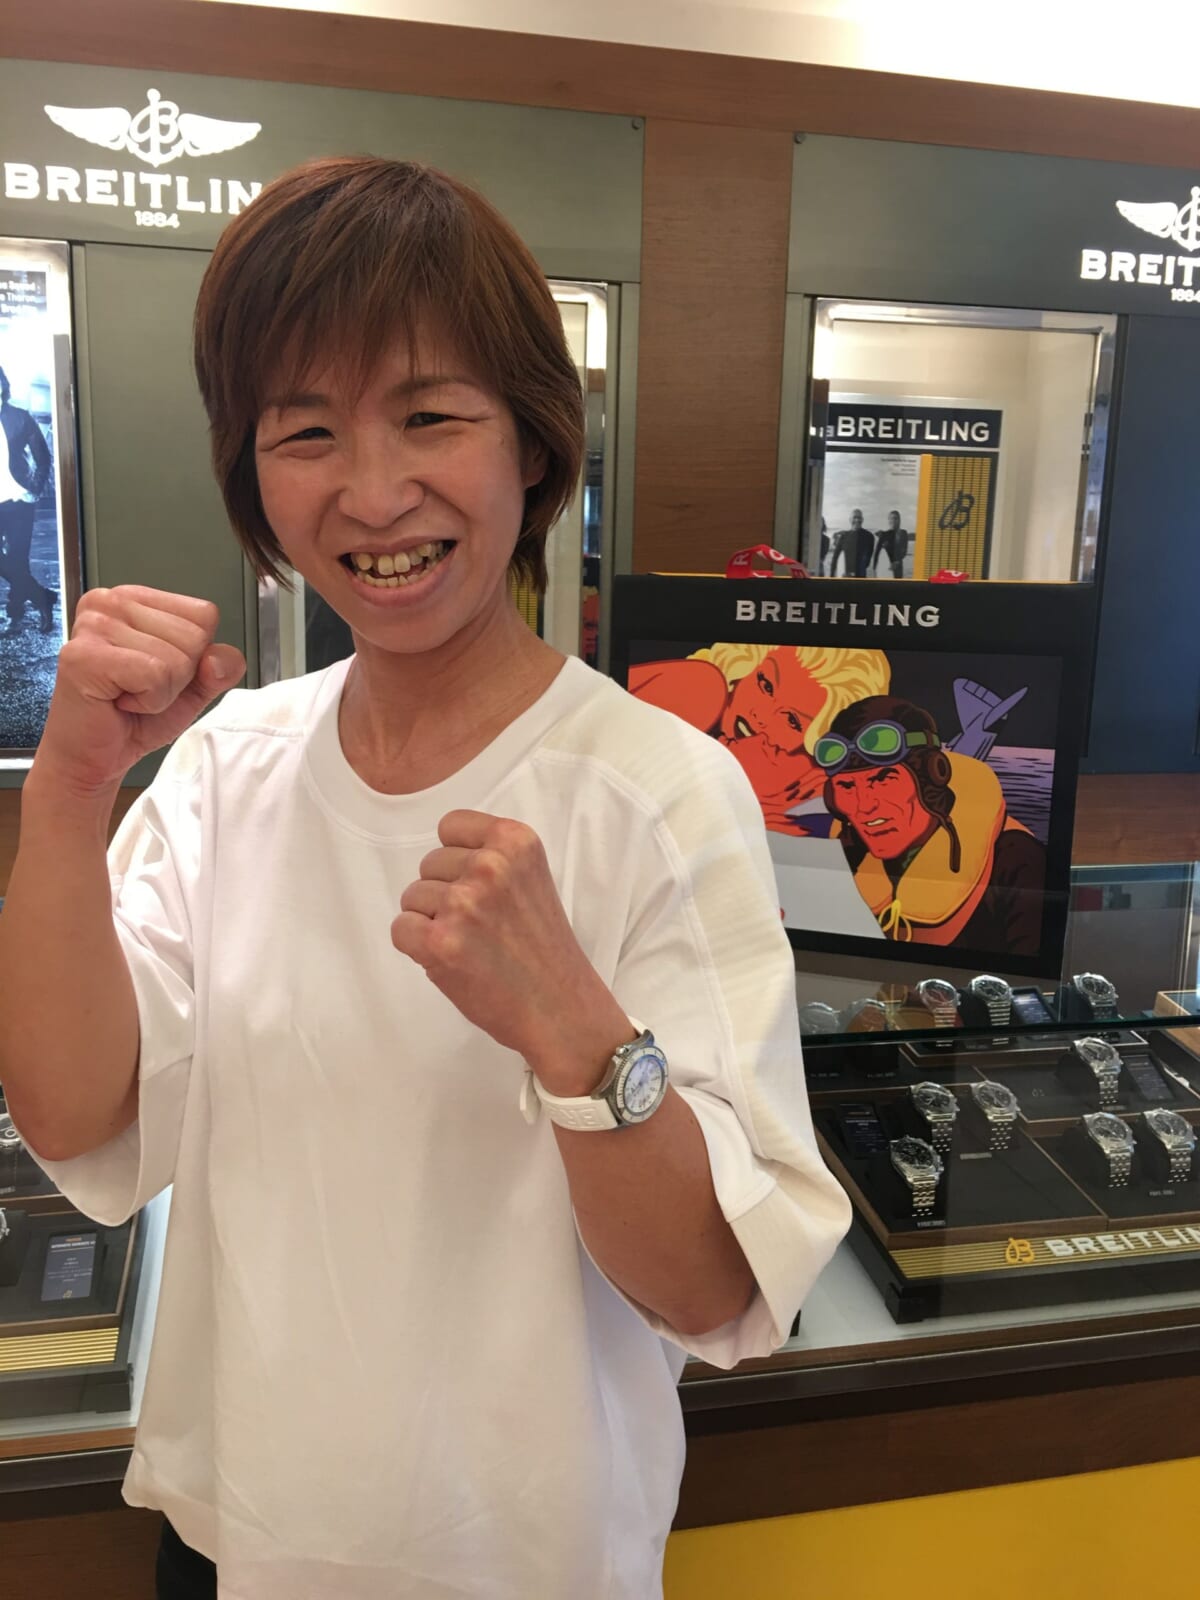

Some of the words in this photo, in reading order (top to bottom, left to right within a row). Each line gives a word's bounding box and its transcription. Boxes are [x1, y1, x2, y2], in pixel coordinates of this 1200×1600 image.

[134, 210, 180, 229] 1884
[837, 415, 990, 442] BREITLING
[735, 599, 940, 628] BREITLING
